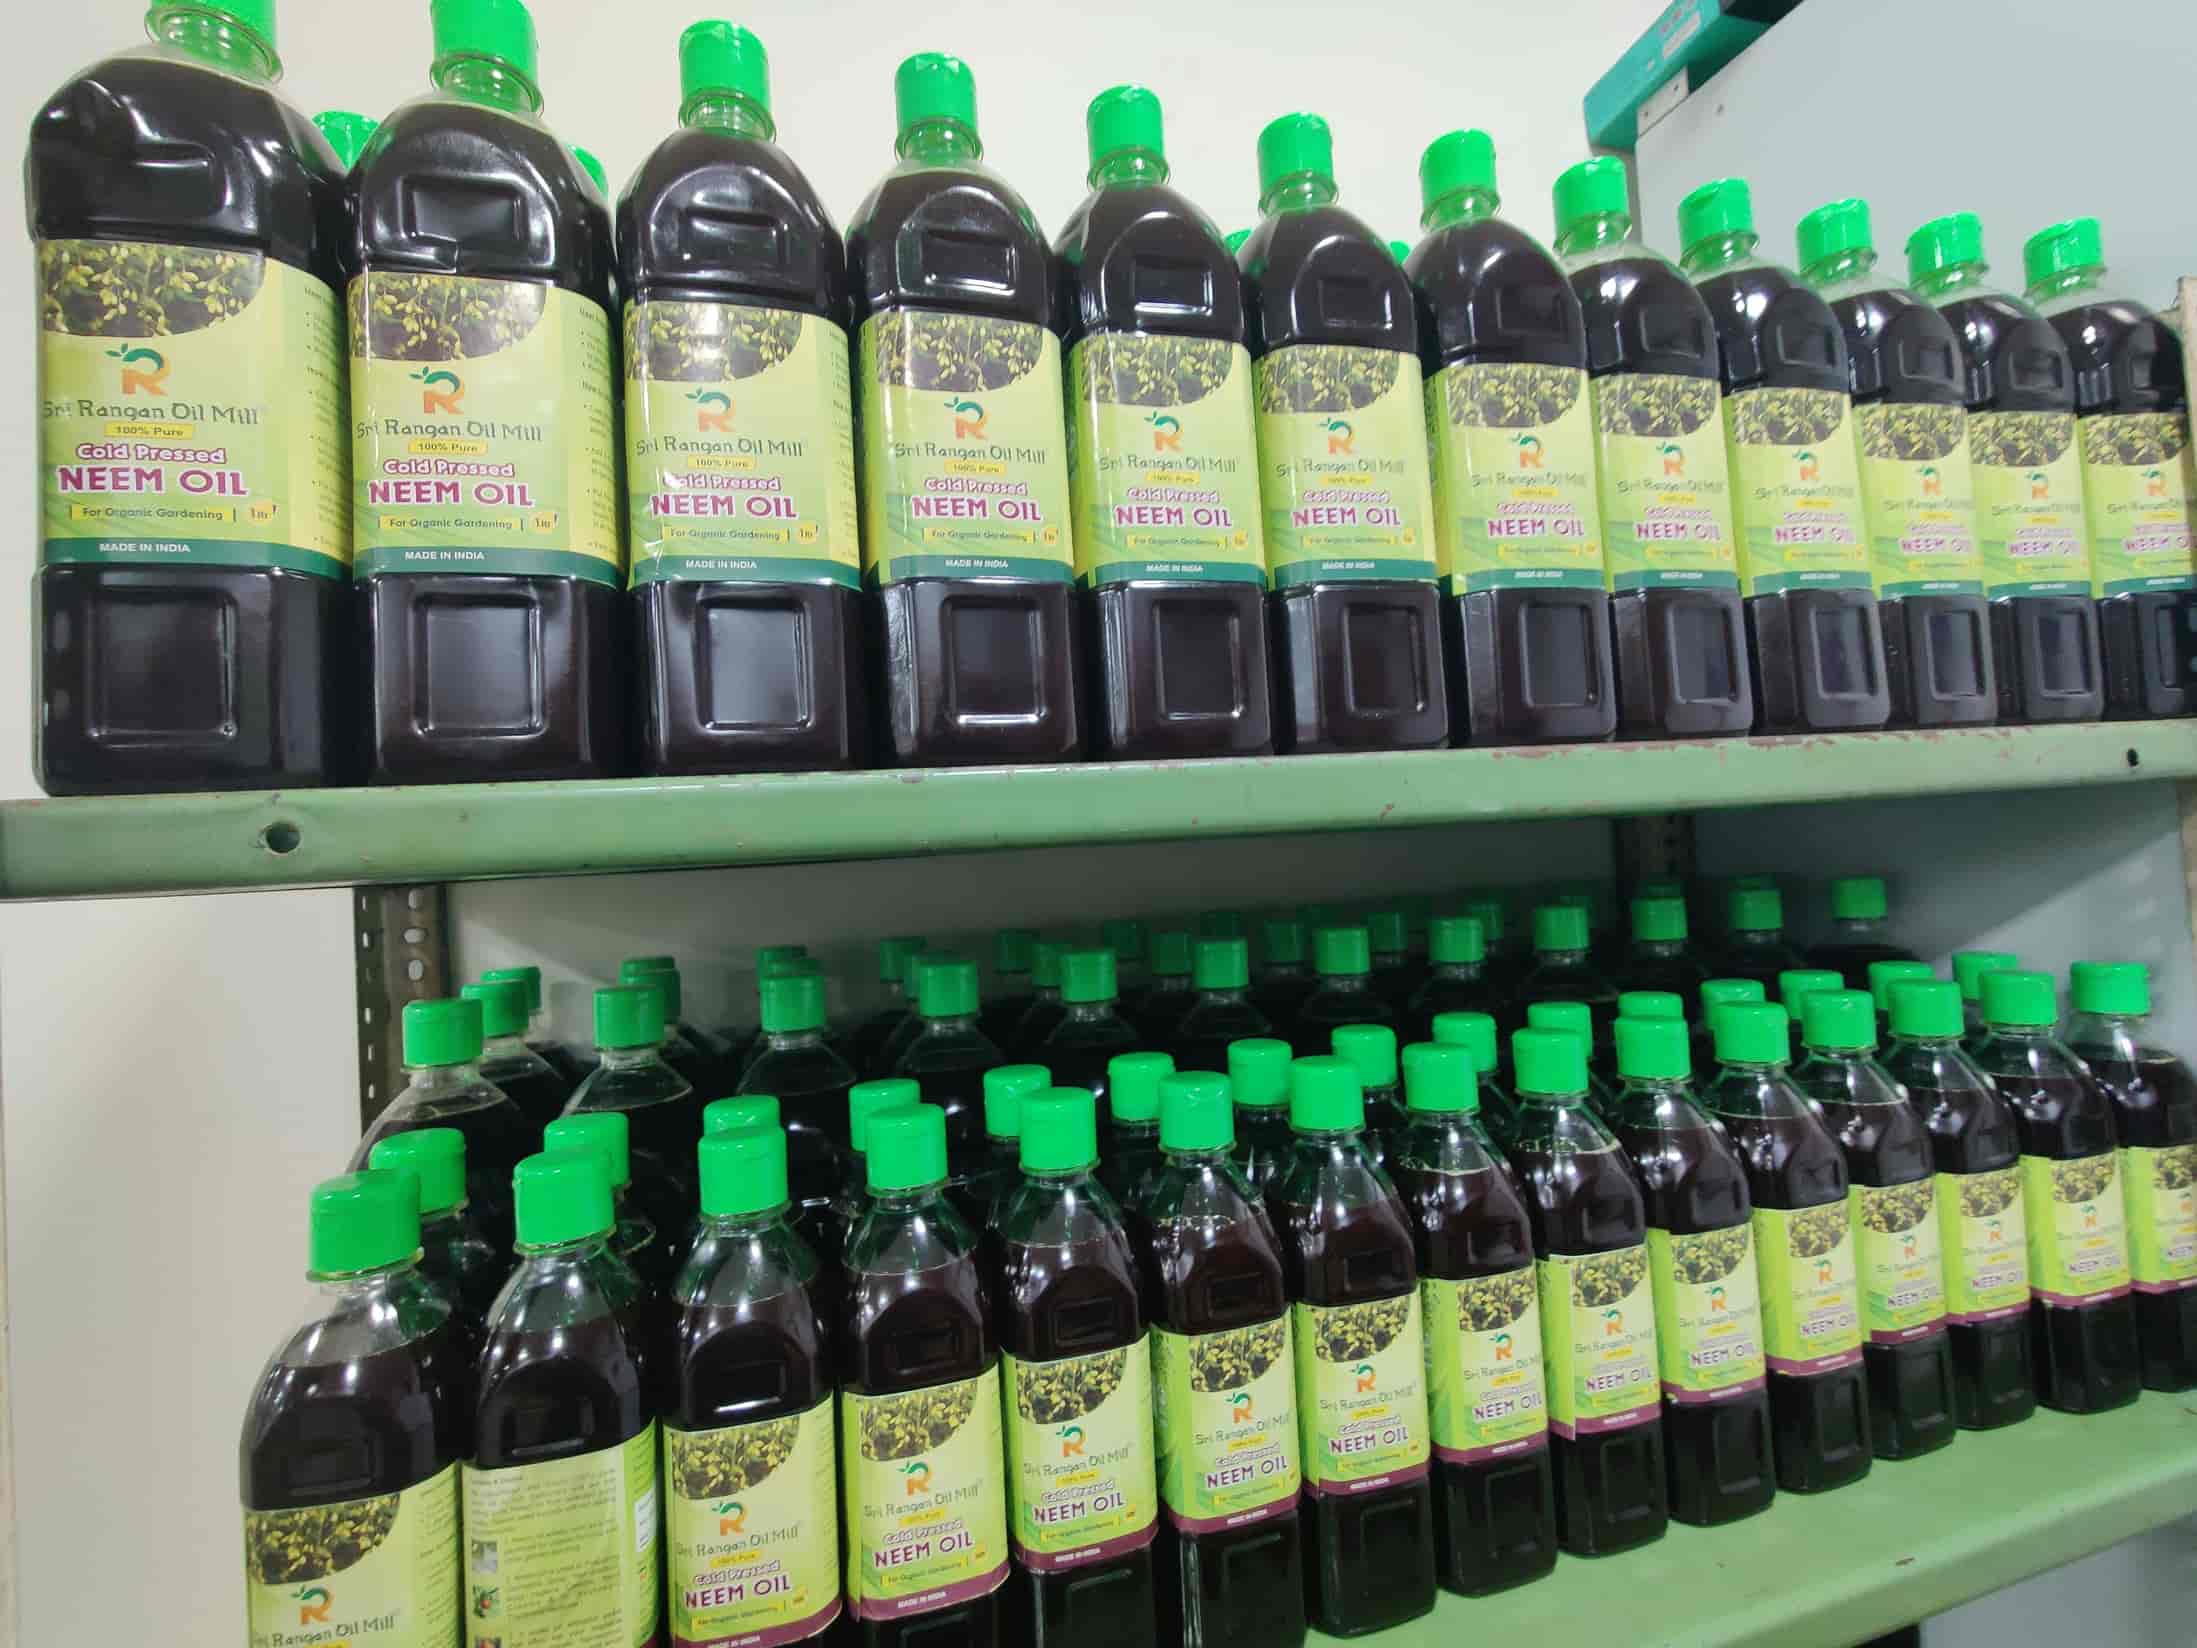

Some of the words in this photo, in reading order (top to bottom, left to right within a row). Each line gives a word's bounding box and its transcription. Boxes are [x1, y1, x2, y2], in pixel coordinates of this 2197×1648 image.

[42, 401, 71, 418] Sri
[78, 400, 164, 420] Rangan
[172, 402, 204, 421] Oil
[212, 406, 258, 424] Mill
[115, 426, 148, 435] 100%
[154, 426, 183, 436] Pure
[357, 422, 379, 438] Sri
[385, 420, 461, 437] Rangan
[467, 421, 496, 438] Oil
[502, 424, 541, 441] Mill
[76, 444, 130, 460] Cold
[136, 446, 226, 464] Pressed
[419, 442, 449, 451] 100%
[452, 443, 478, 452] Pure
[636, 440, 658, 456] Sri
[664, 436, 732, 454] Rangan
[738, 439, 762, 454] Oil
[768, 440, 802, 456] Mill
[896, 443, 920, 457] Sri
[925, 443, 986, 461] Rangan
[990, 446, 1011, 460] Oil
[1016, 448, 1045, 464] Mill
[384, 459, 431, 474] Cold
[435, 460, 515, 477] Pressed
[59, 467, 162, 492] NEEM
[180, 469, 248, 496] OIL
[711, 475, 781, 491] Pressed
[925, 478, 963, 493] Cold
[967, 480, 1027, 496] Pressed
[370, 482, 460, 504] NEEM
[474, 483, 533, 506] OIL
[83, 506, 102, 516] For
[105, 507, 152, 520] Organic
[156, 508, 223, 520] Gardening
[651, 495, 734, 516] NEEM
[746, 496, 797, 518] OIL
[912, 496, 987, 517] NEEM
[999, 501, 1041, 520] OIL
[1116, 506, 1183, 525] NEEM
[1194, 507, 1232, 527] OIL
[390, 518, 406, 528] For
[410, 518, 450, 529] Organic
[455, 519, 512, 530] Gardening
[1293, 508, 1356, 526] NEEM
[1366, 508, 1400, 525] OIL
[1488, 520, 1545, 536] NEEM
[1554, 520, 1584, 536] OIL
[100, 544, 136, 552] MADE
[140, 544, 152, 552] IN
[156, 544, 190, 552] INDIA
[405, 551, 436, 560] MADE
[440, 552, 451, 560] IN
[455, 552, 485, 560] INDIA
[686, 560, 715, 568] MADE
[1330, 1434, 1376, 1453] NEEM
[1383, 1427, 1408, 1444] OIL
[1207, 1466, 1253, 1488] NEEM
[1261, 1456, 1287, 1474] OIL
[1034, 1502, 1085, 1522] NEEM
[1094, 1493, 1124, 1511] OIL
[750, 1533, 768, 1547] Oil
[875, 1542, 930, 1568] NEEM
[940, 1531, 973, 1553] OIL
[686, 1585, 743, 1608] NEEM
[754, 1575, 790, 1595] OIL
[272, 1629, 332, 1647] Rangan
[336, 1623, 358, 1637] Oil
[364, 1616, 394, 1632] Mill
